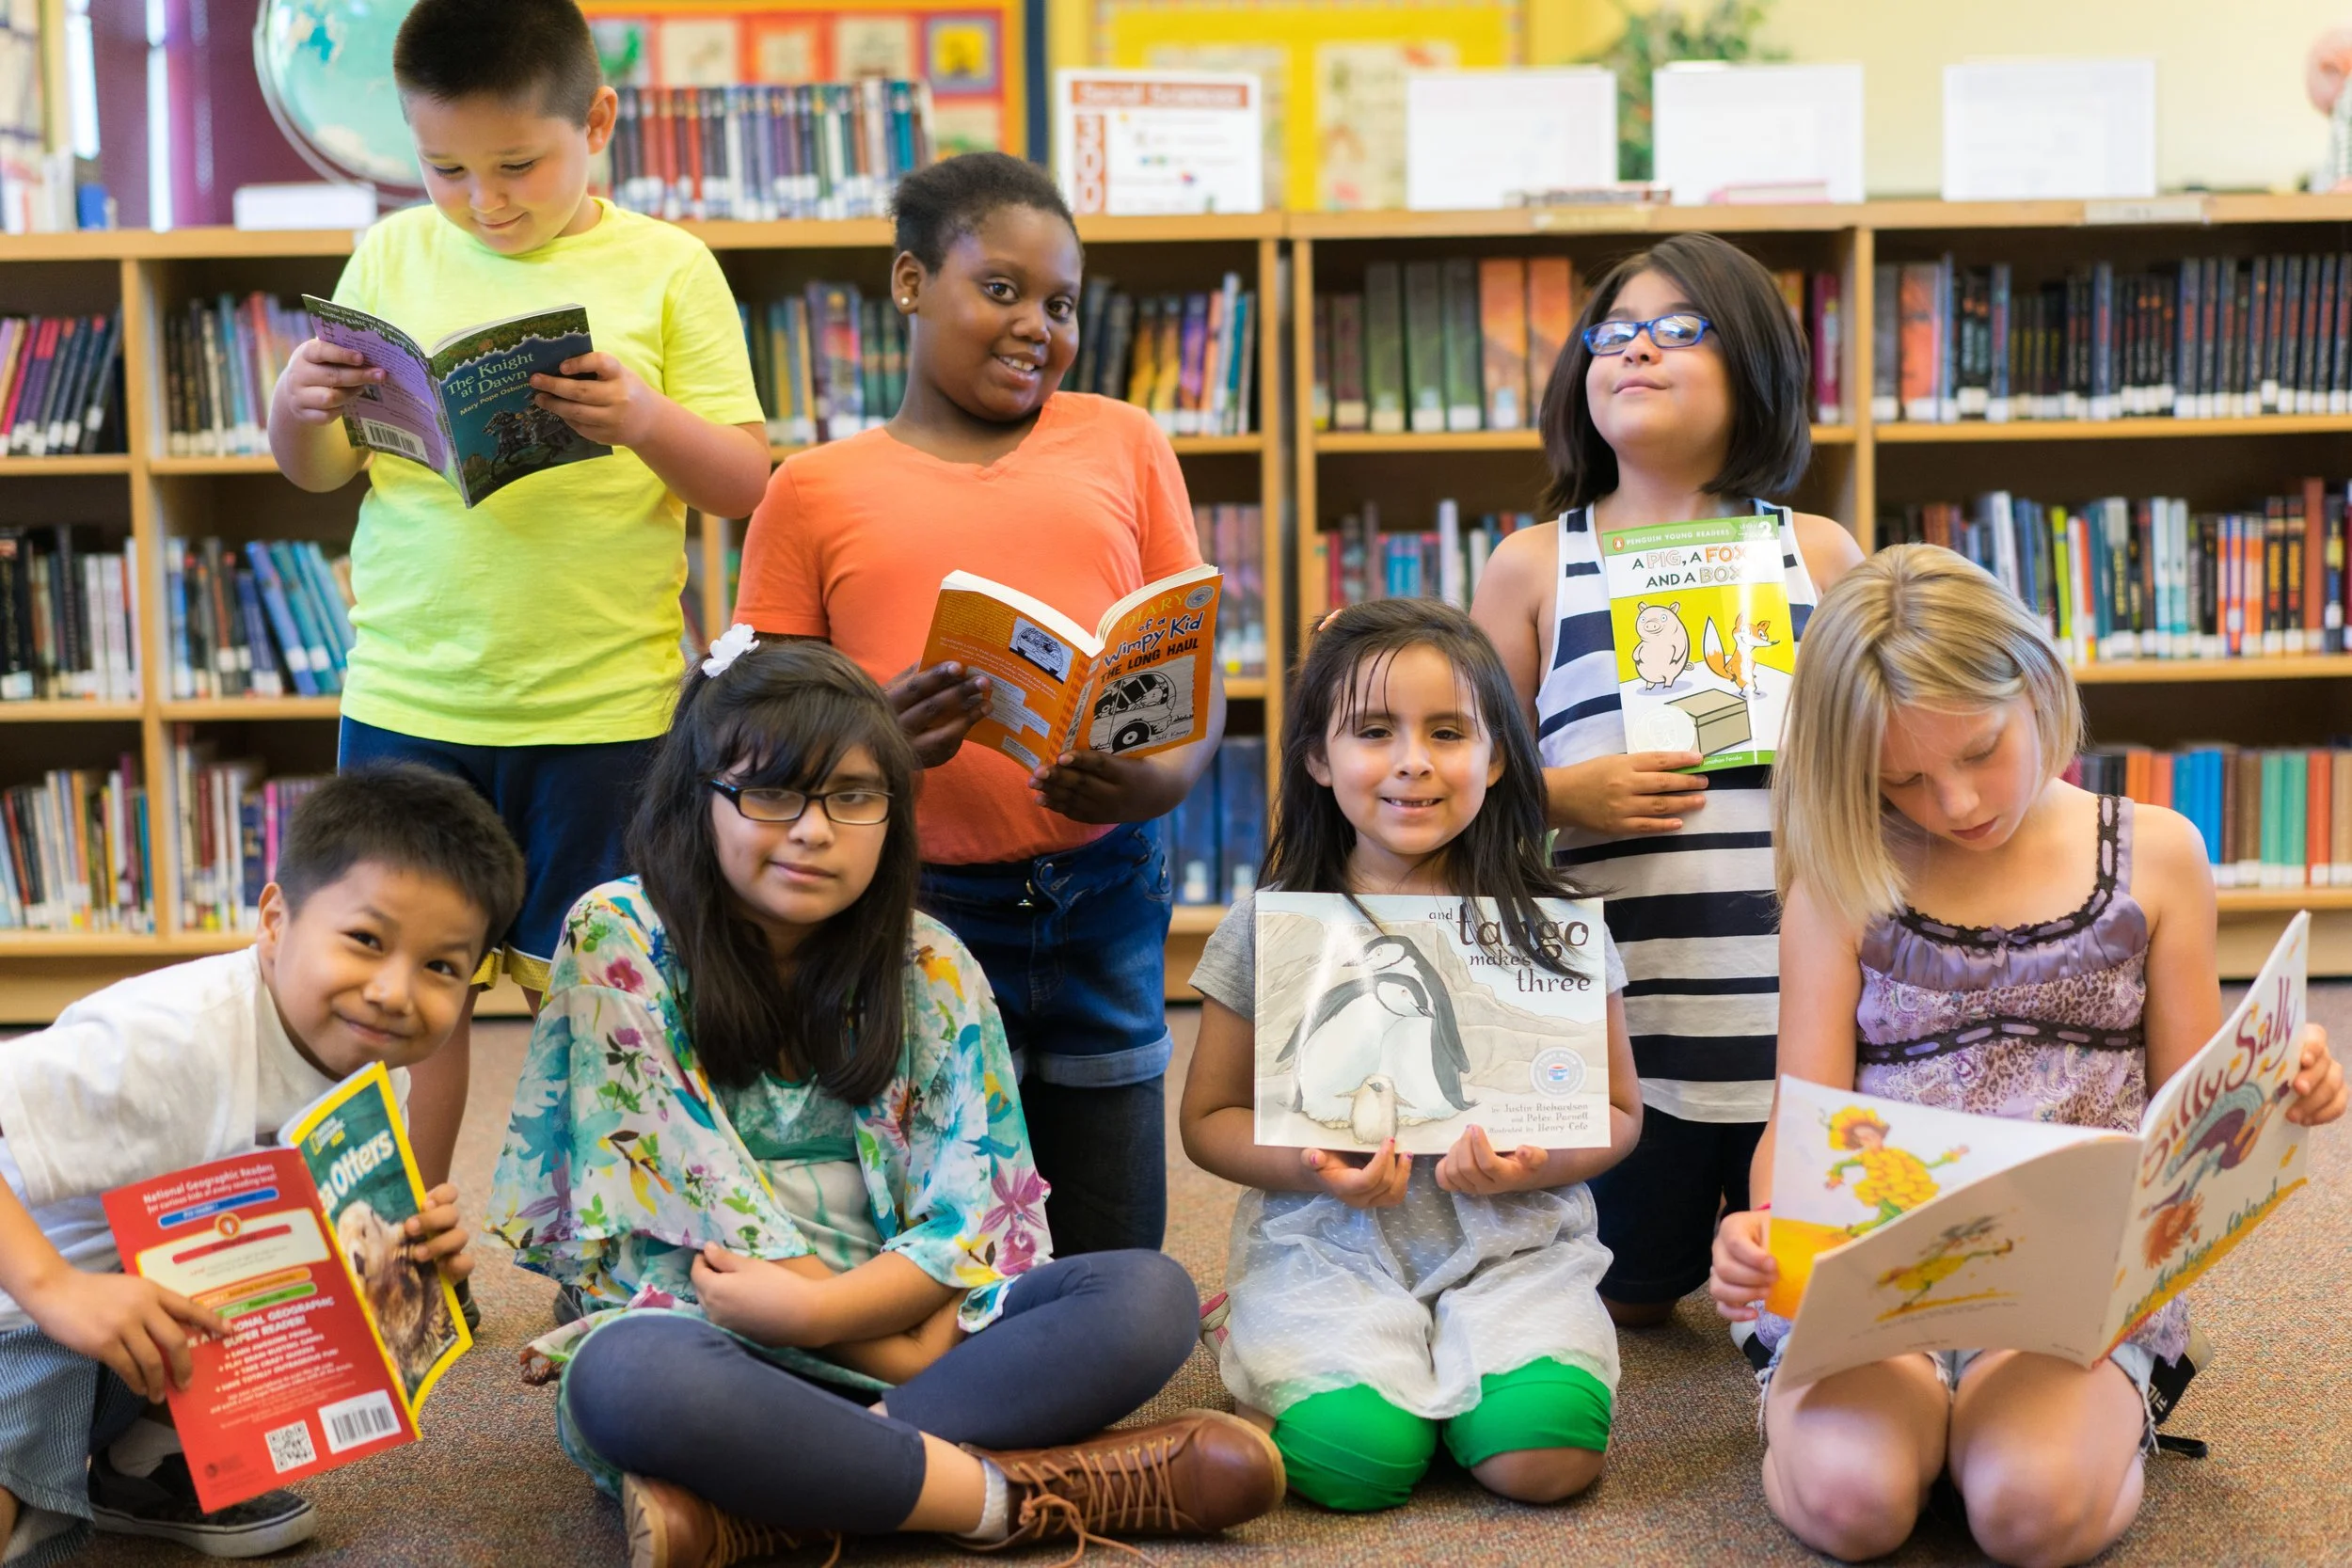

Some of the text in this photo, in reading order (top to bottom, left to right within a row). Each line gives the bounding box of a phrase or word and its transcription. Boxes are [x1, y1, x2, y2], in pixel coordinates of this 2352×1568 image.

[446, 353, 535, 396] The Knight
[460, 371, 528, 398] at Dawn
[459, 402, 479, 416] Mary
[479, 392, 499, 404] Pope
[1626, 535, 1661, 546] PENGUIN
[1664, 531, 1693, 541] YOUNG
[1696, 529, 1730, 538] READERS
[1757, 520, 1772, 537] 2
[1631, 558, 1645, 570] A
[1646, 549, 1687, 570] PIG,
[1690, 551, 1703, 563] A
[1645, 564, 1741, 589] AND A BOX
[1122, 592, 1187, 631] DIARY
[1137, 617, 1167, 632] of a
[1104, 610, 1205, 667] Wimpy Kid
[1100, 638, 1199, 684] THE LONG HAUL
[1428, 908, 1454, 920] and
[1470, 949, 1533, 967] makes
[1516, 969, 1592, 993] three
[2140, 974, 2298, 1190] Silly Sally
[1504, 1103, 1534, 1114] Justin
[1535, 1101, 1589, 1112] Richardson
[1526, 1113, 1552, 1122] Peter
[1537, 1122, 1565, 1132] Henry
[1568, 1121, 1589, 1131] Cole
[330, 1129, 395, 1198] Otters
[143, 1164, 276, 1205] National Geographic Readers
[266, 1296, 335, 1322] GEOGRAPHIC
[222, 1328, 260, 1350] SUPER
